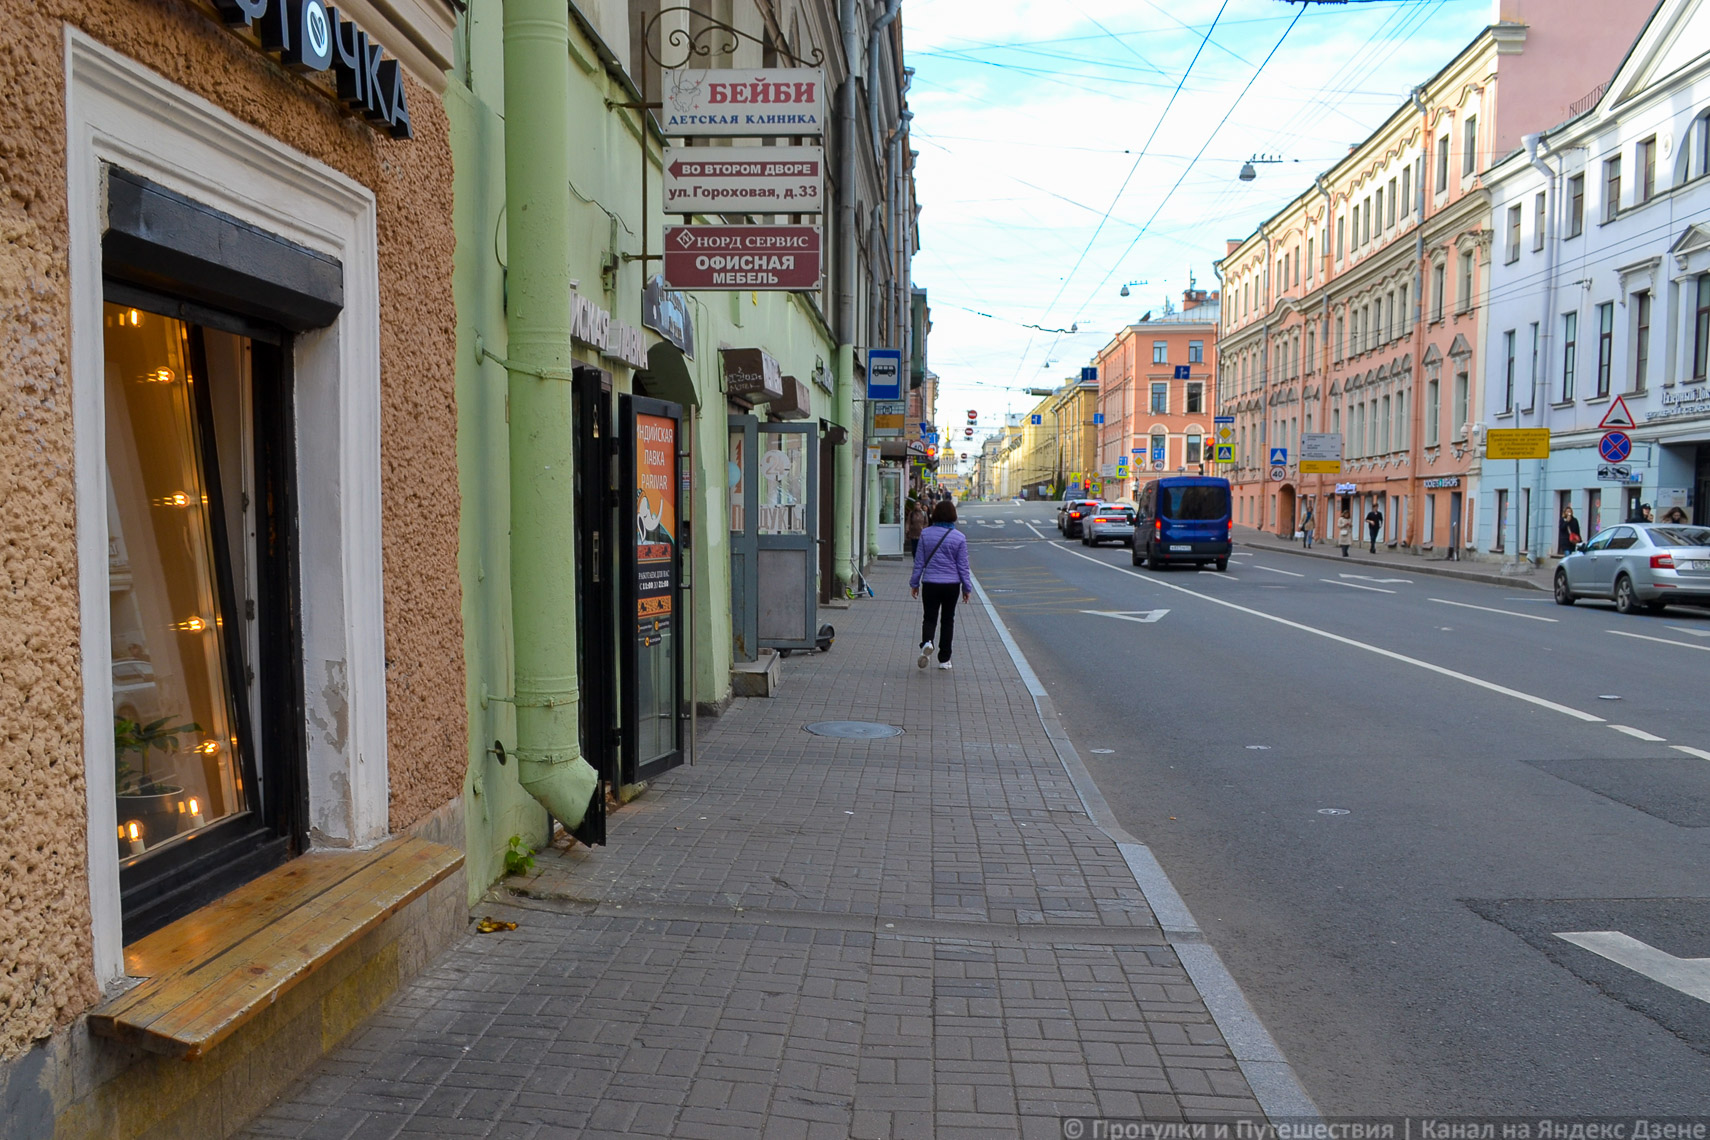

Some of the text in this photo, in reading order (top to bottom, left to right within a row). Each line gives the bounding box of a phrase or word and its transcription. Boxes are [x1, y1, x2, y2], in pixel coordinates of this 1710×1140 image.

[708, 77, 816, 104] БЕЙБИ
[668, 114, 817, 126] ДЕТСКАЯ КЛИНИКА
[682, 164, 811, 176] ВО ВТОРОМ ДВОРЕ
[784, 185, 818, 200] д.33
[696, 236, 809, 249] НОРД СЕРВИС
[695, 255, 795, 270] ОФИСНАЯ
[713, 273, 779, 284] МЕБЕЛЬ
[644, 449, 665, 467] ЛАВКА
[1272, 470, 1284, 478] 40
[641, 473, 668, 490] PARIVAR
